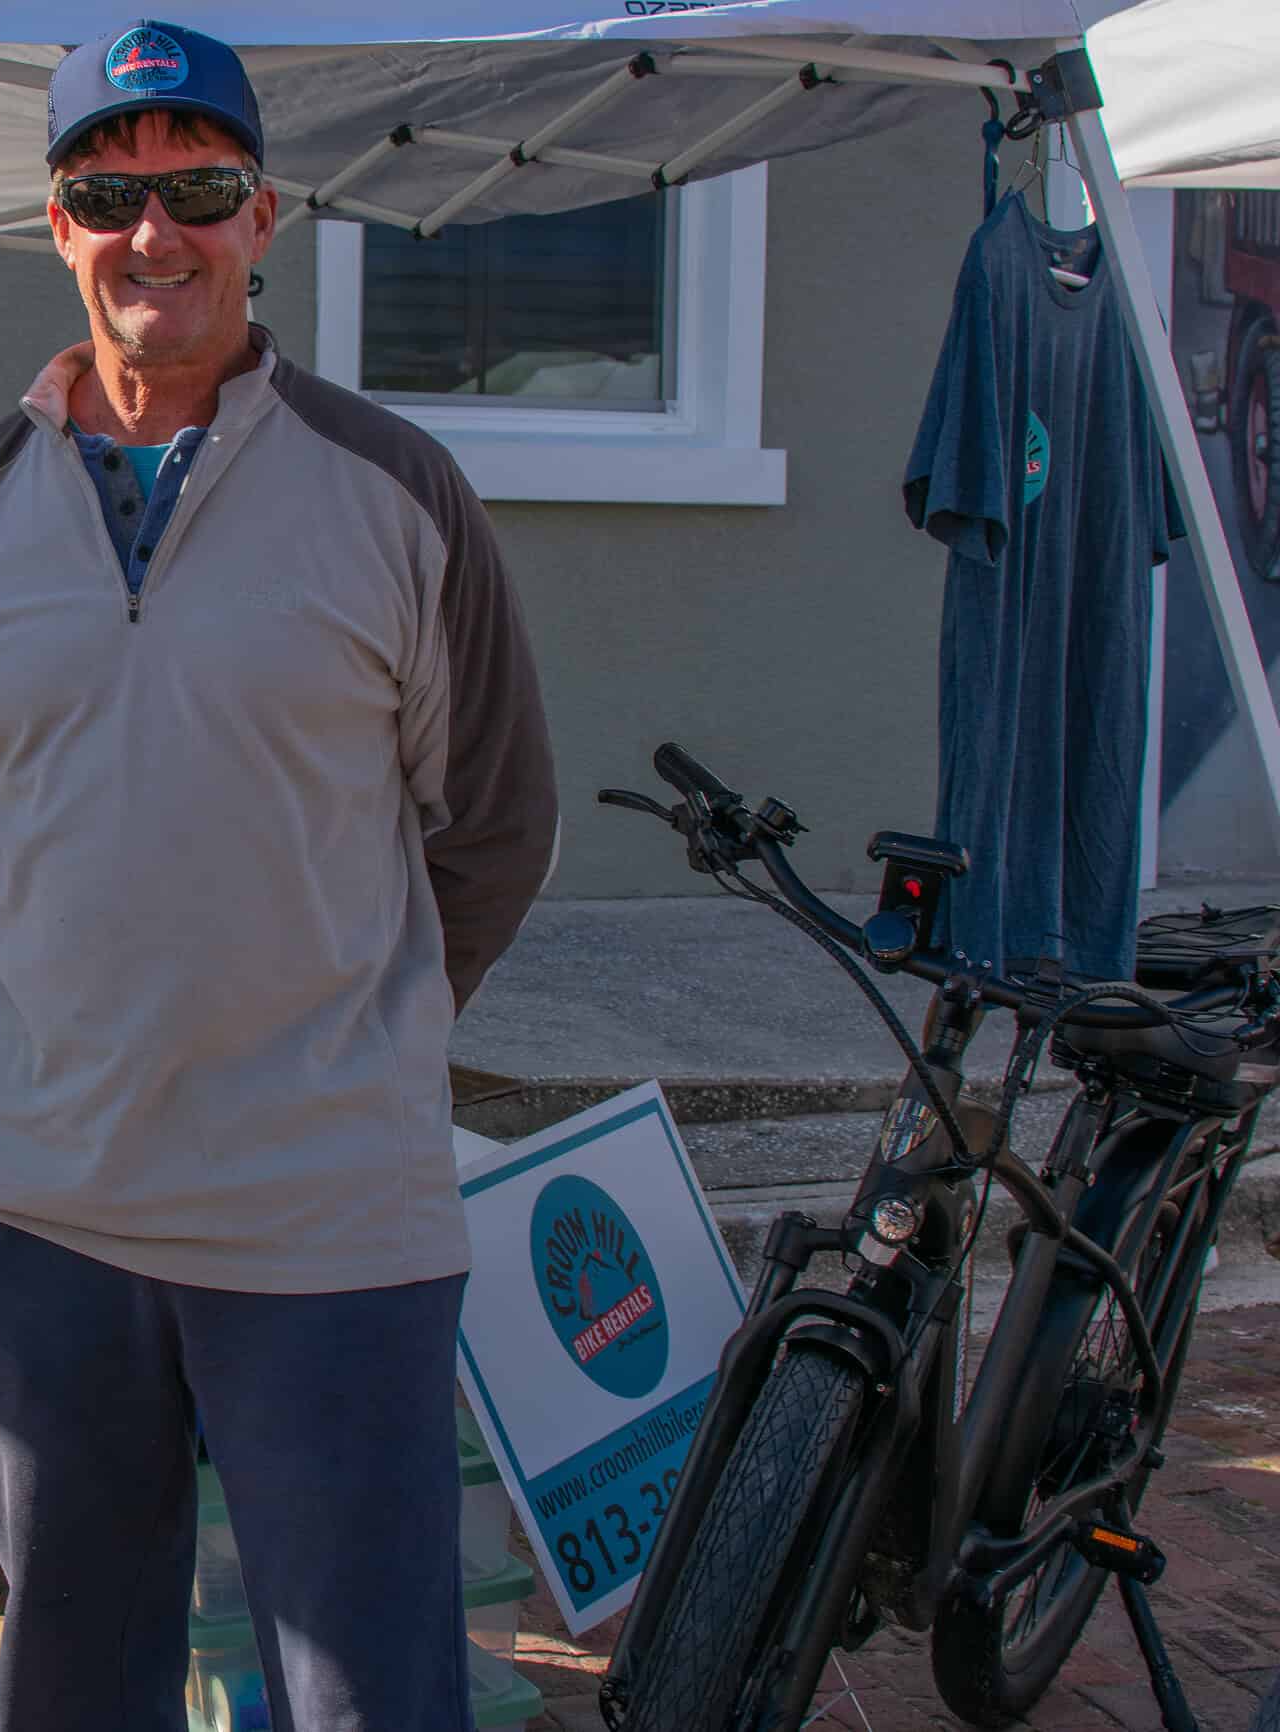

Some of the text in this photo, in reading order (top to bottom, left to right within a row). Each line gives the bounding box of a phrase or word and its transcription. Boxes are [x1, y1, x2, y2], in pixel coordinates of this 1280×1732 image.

[545, 1207, 641, 1318] CROOM HILL
[573, 1322, 607, 1362] BIKE
[600, 1283, 654, 1338] RENTALS
